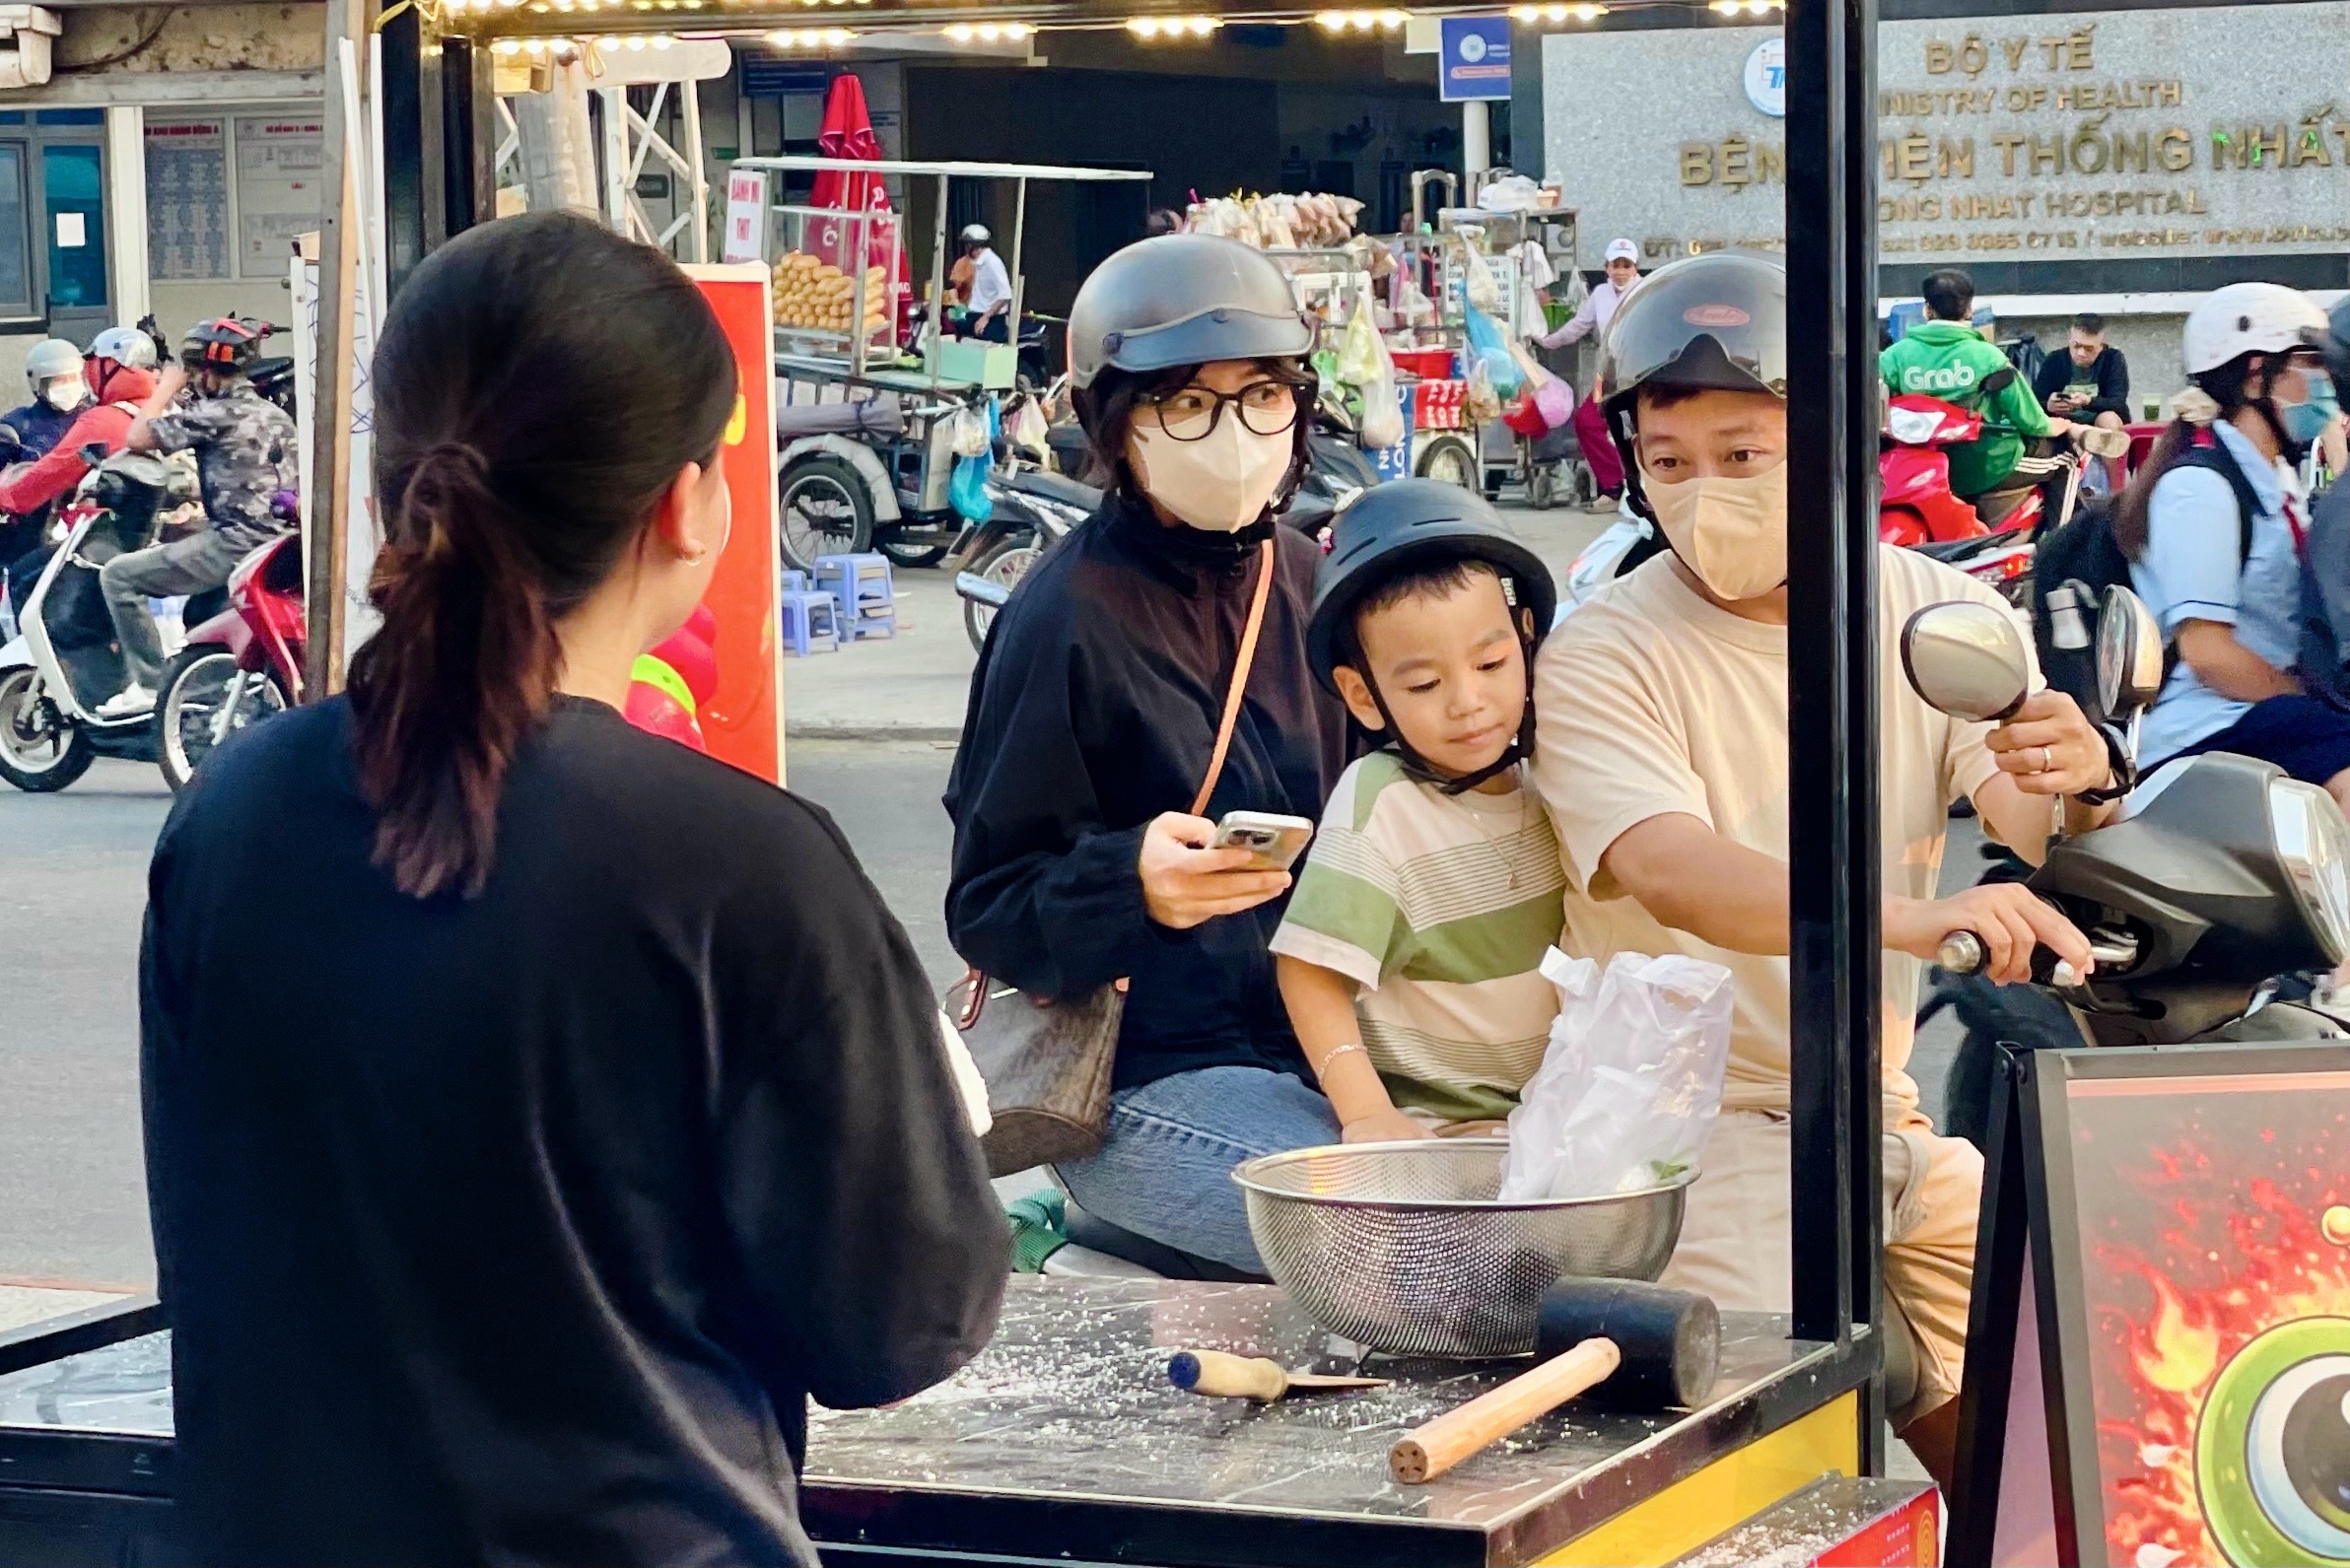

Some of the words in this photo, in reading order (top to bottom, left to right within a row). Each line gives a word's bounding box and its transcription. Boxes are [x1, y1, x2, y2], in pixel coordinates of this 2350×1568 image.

[1925, 33, 1988, 80] BỘ
[2000, 36, 2028, 71] Y
[2039, 23, 2098, 70] TẾ
[2007, 85, 2048, 112] OF
[2057, 79, 2182, 111] HEALTH
[1680, 131, 1785, 194] BỆN
[1878, 126, 1973, 190] IỆN
[1991, 111, 2194, 177] THỐNG
[1951, 190, 2036, 222] NHAT
[2045, 189, 2208, 220] HOSPITAL
[1904, 358, 1974, 392] Grab
